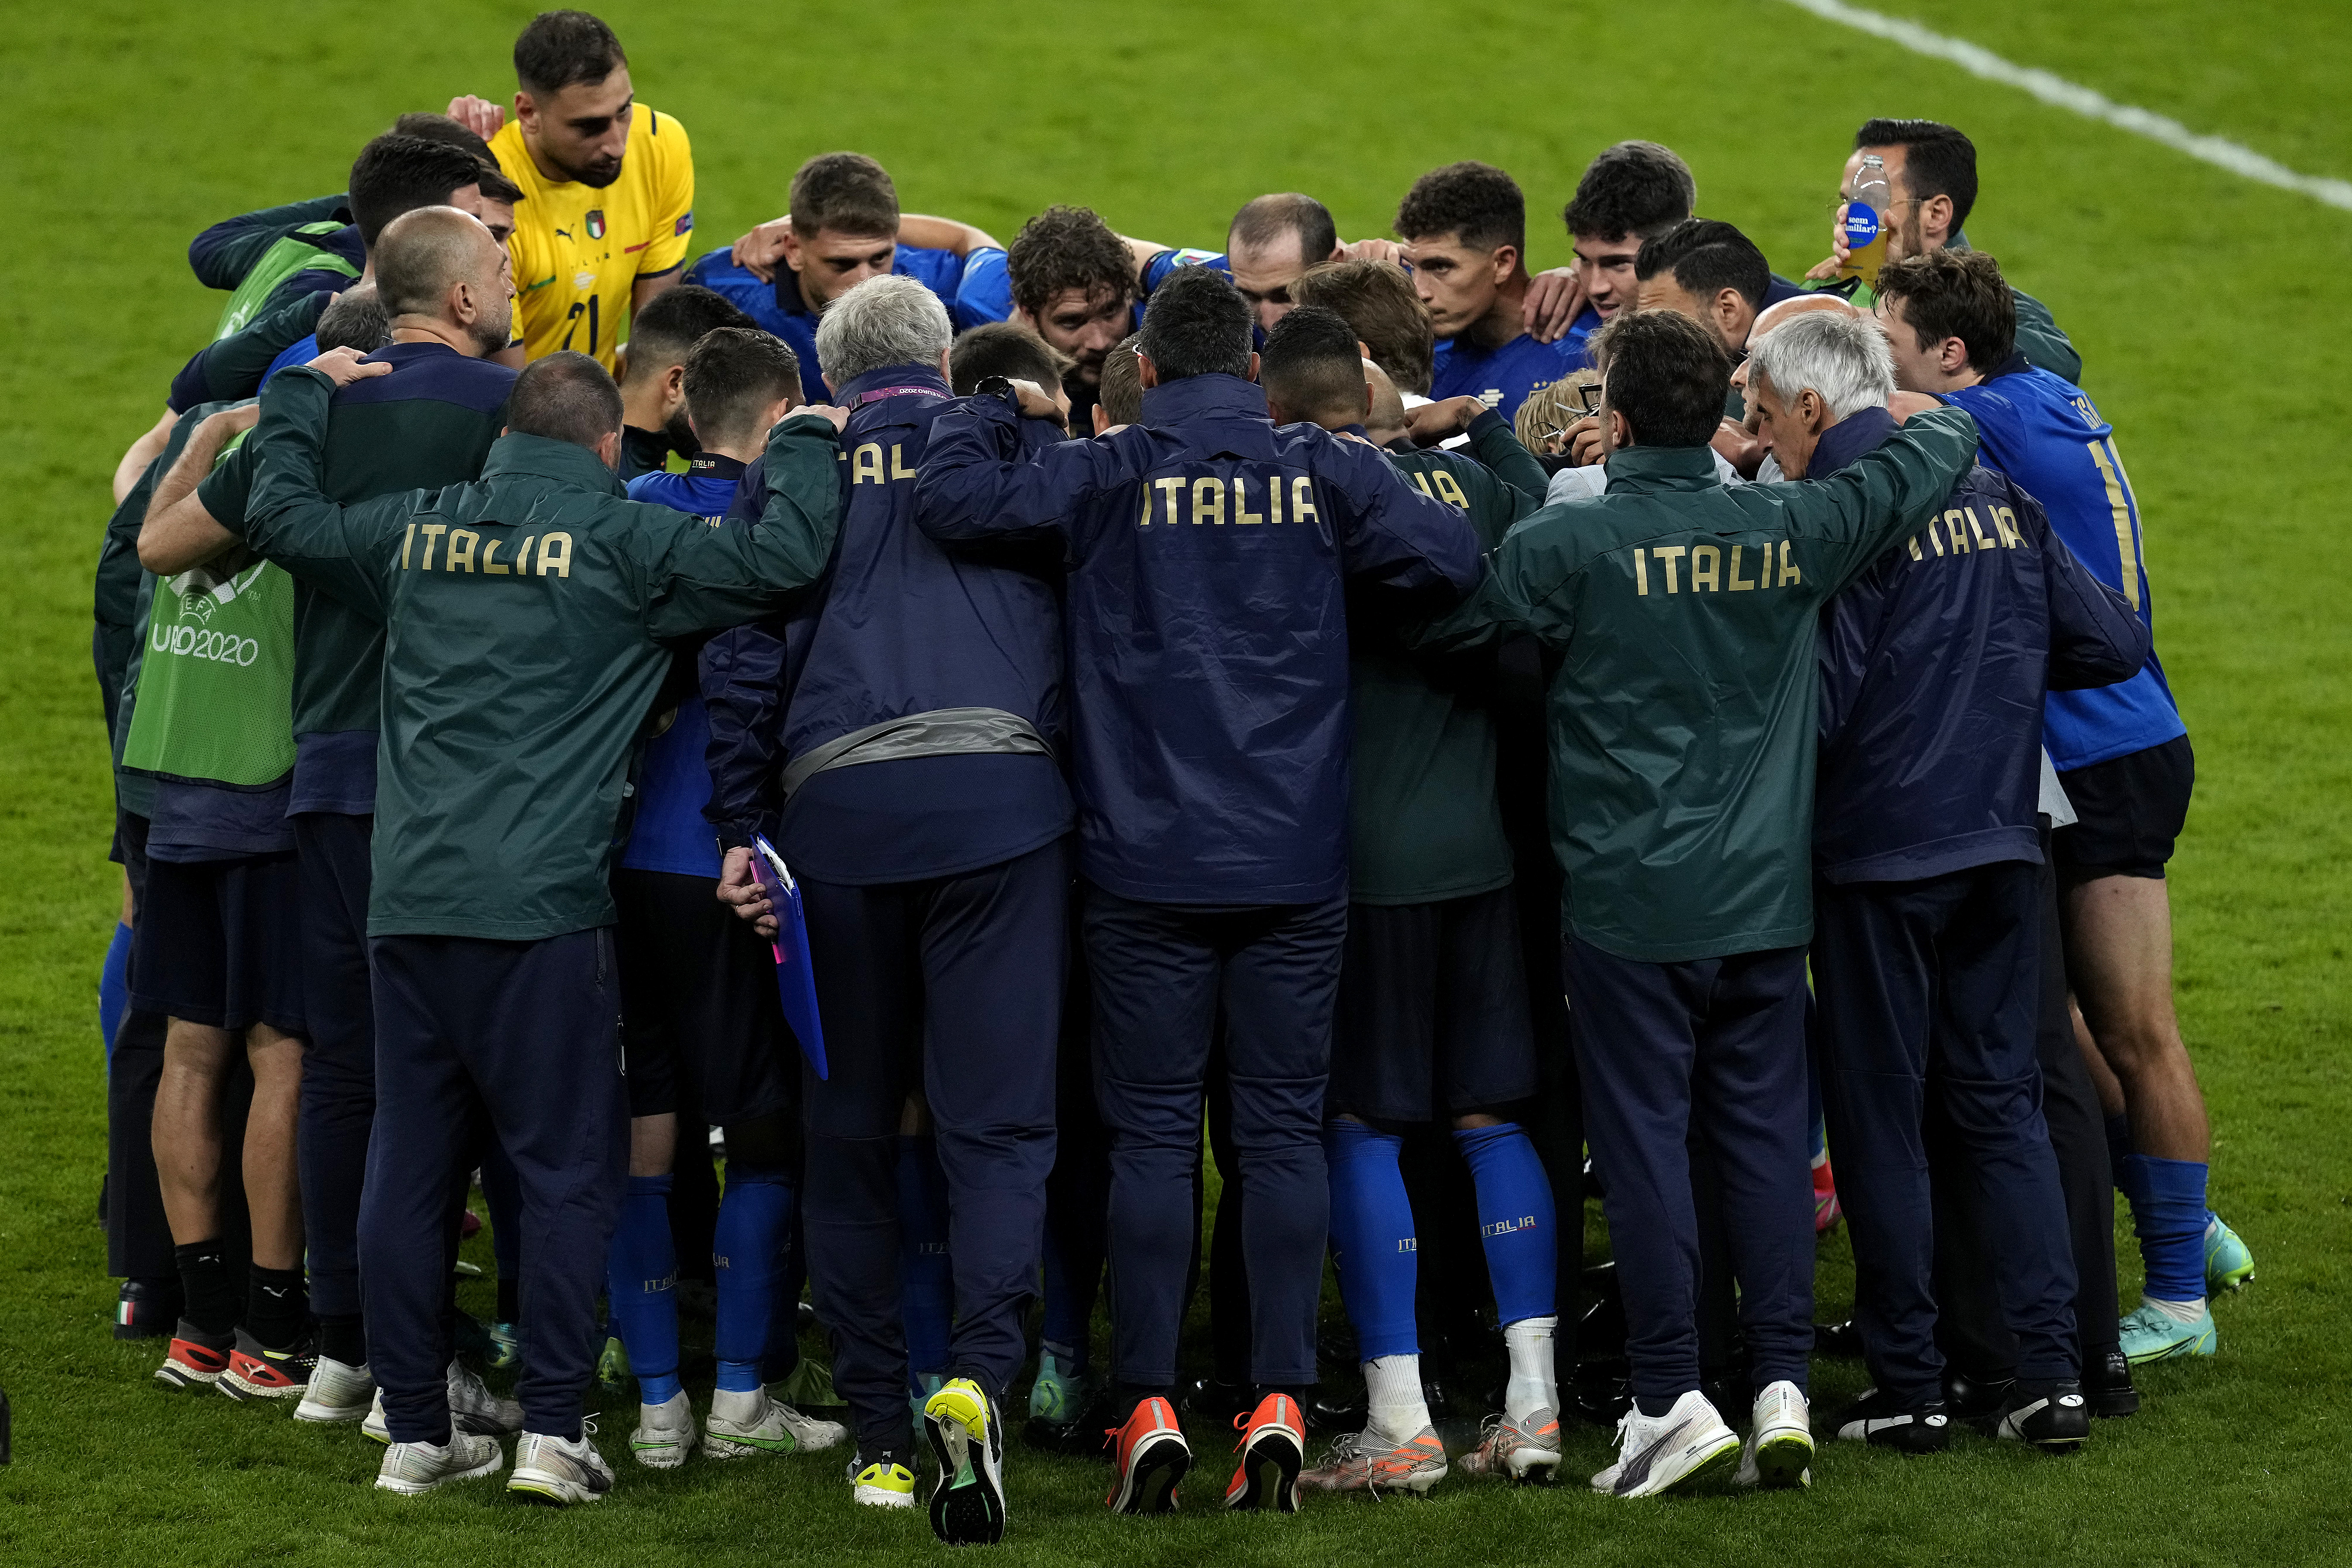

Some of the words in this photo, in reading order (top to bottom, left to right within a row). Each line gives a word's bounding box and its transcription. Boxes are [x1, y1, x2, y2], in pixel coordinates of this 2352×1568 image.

[1845, 224, 1877, 233] amiliar?
[562, 294, 598, 356] 21
[918, 388, 938, 397] EURO
[1140, 476, 1320, 525] ITALIA
[402, 524, 573, 578] ITALIA
[1908, 505, 2029, 561] ITALIA
[1634, 540, 1801, 596] ITALIA
[1482, 1216, 1536, 1236] ITALIA
